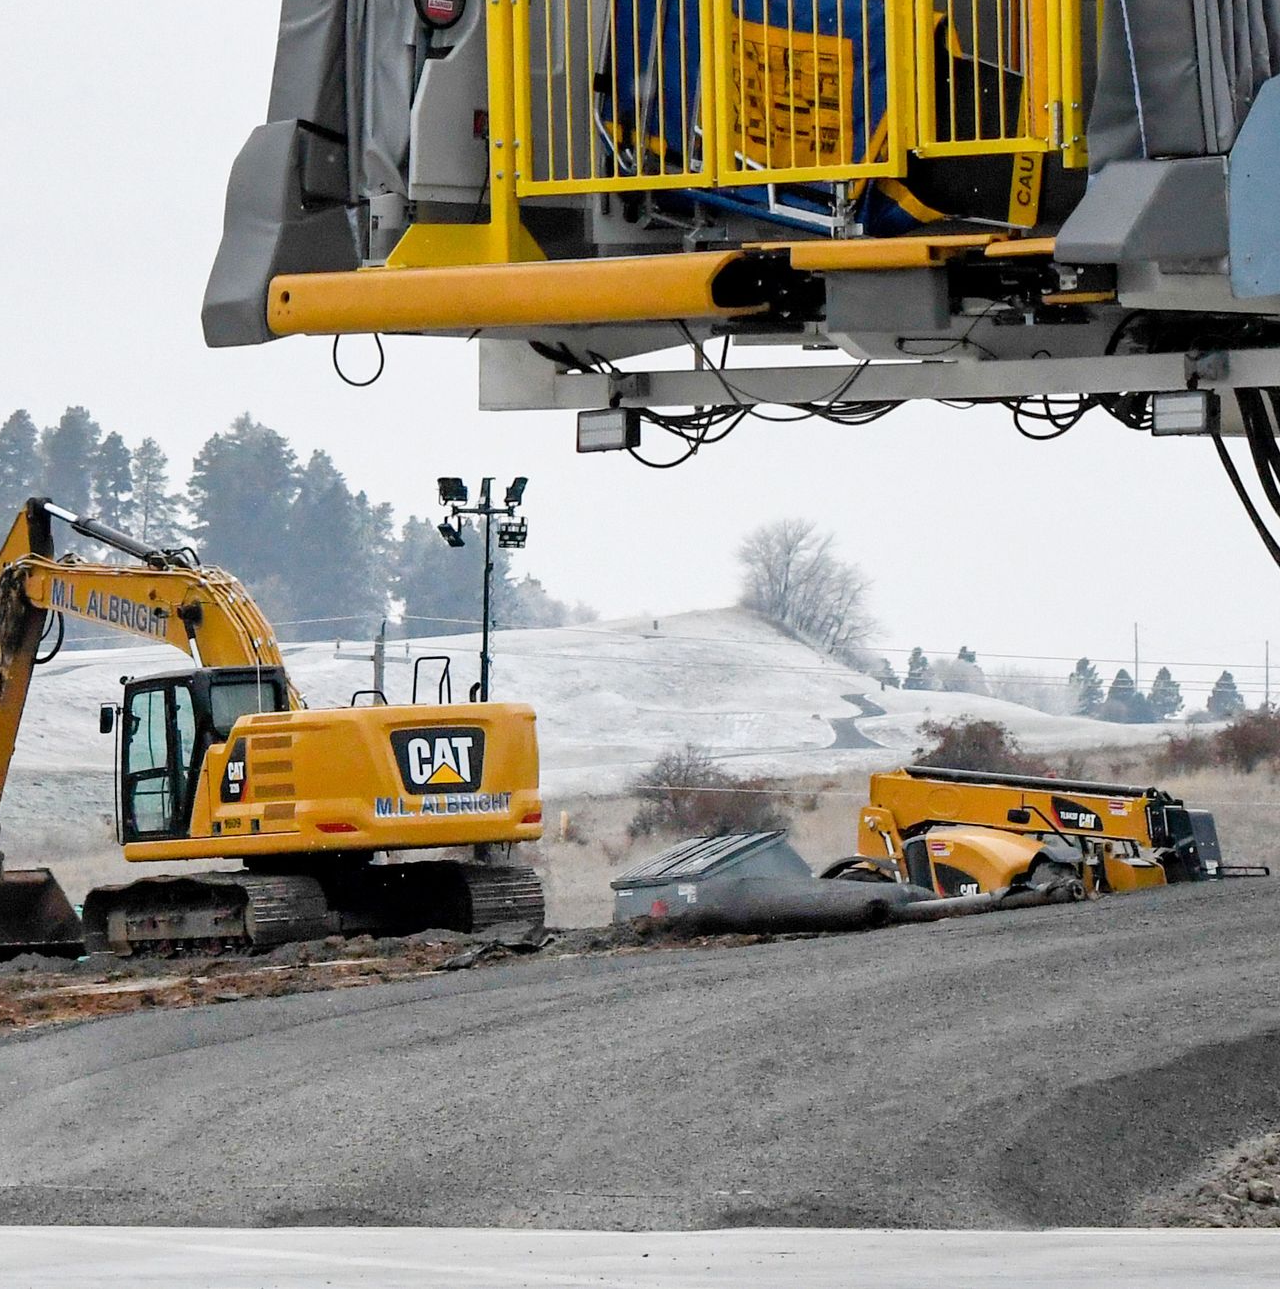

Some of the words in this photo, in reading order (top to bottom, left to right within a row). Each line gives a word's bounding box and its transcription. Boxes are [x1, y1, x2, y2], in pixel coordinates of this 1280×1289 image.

[51, 577, 82, 613] M.L.
[227, 761, 244, 781] CAT
[407, 736, 474, 785] CAT
[375, 796, 415, 818] M.L.
[419, 791, 512, 817] ALBRIGHT
[1078, 812, 1096, 829] CAT
[960, 883, 978, 896] CAT
